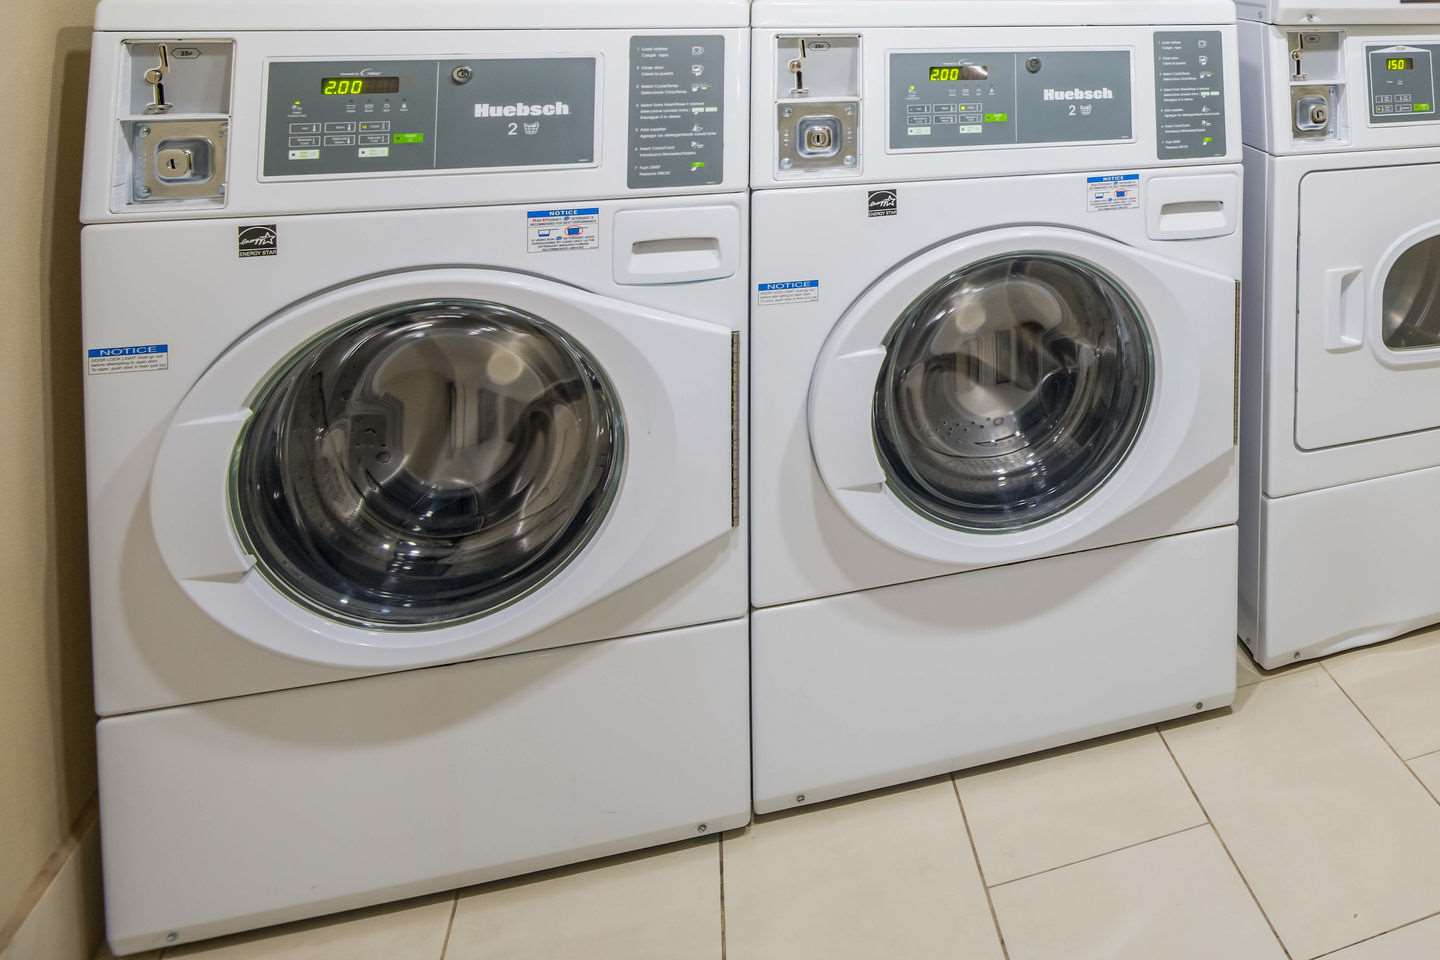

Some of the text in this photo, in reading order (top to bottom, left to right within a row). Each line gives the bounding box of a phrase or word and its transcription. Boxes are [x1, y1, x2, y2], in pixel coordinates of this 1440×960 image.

[930, 68, 960, 81] 2.00
[324, 80, 363, 95] 2.00
[1043, 88, 1113, 101] Huebsch
[474, 101, 569, 118] Huebsch
[1068, 104, 1077, 116] 2
[507, 122, 518, 136] 2
[548, 209, 579, 217] NOTICE
[767, 280, 809, 290] NOTICE
[100, 346, 158, 357] NOTICE
